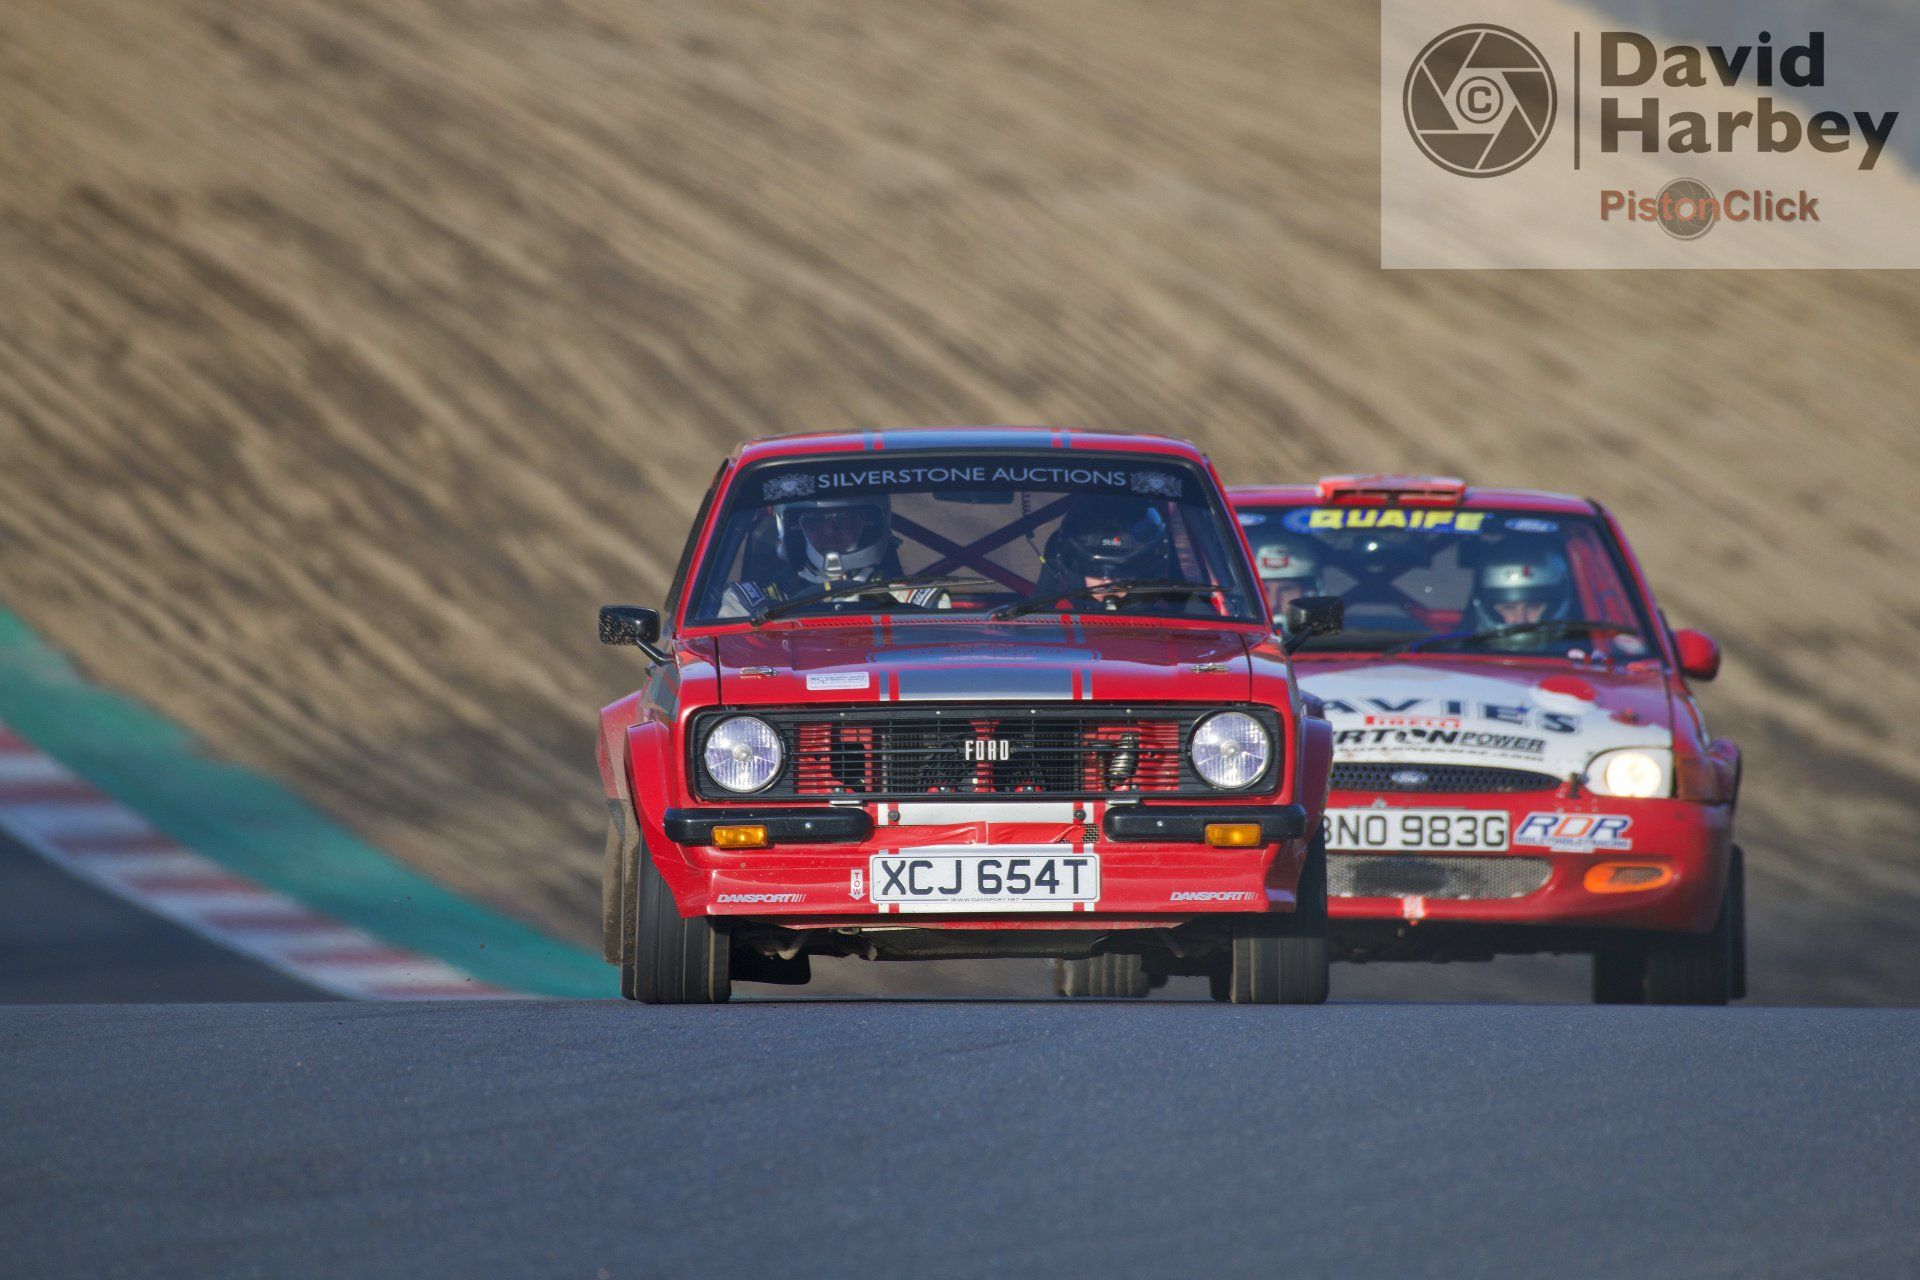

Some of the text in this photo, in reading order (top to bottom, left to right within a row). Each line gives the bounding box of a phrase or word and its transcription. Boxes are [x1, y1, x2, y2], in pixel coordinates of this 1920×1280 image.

[817, 466, 1127, 489] SILVERSTONE AUCTIONS
[1308, 509, 1486, 532] QUAIFE
[965, 739, 1009, 761] FORD
[1332, 728, 1459, 746] RTON
[1459, 730, 1547, 754] POWER
[1401, 815, 1506, 847] 983G
[1518, 814, 1630, 839] RDR
[852, 871, 862, 896] TOW
[881, 859, 1089, 896] XCJ 654T
